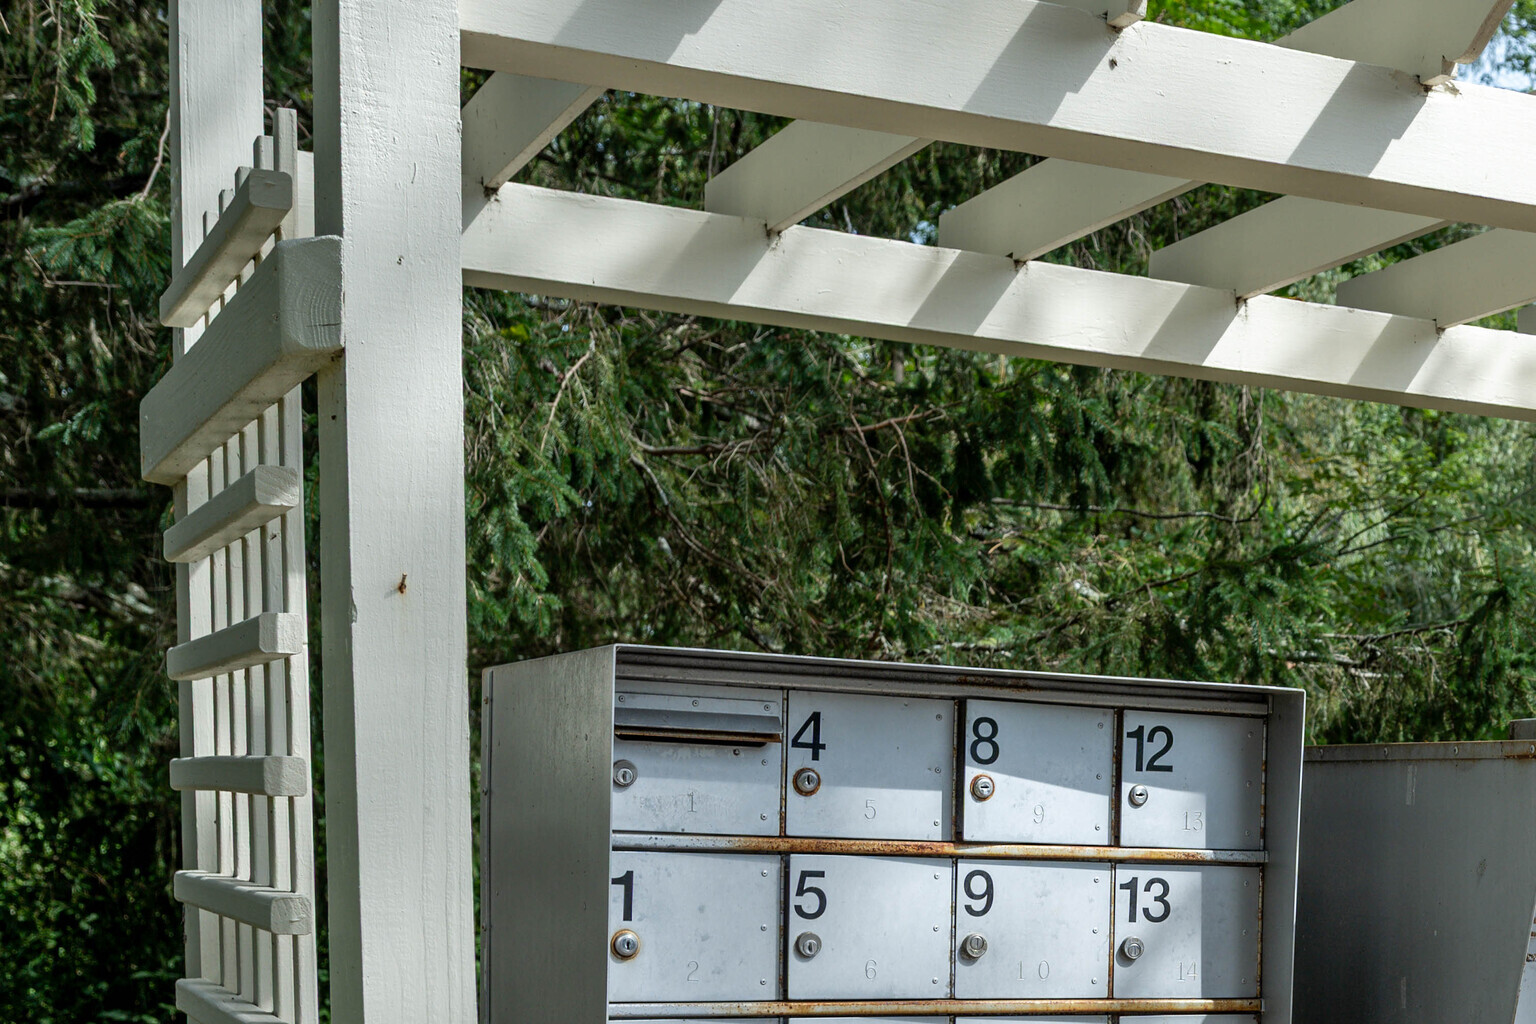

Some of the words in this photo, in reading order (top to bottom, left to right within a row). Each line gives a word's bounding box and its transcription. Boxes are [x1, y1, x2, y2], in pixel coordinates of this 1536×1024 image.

[790, 711, 827, 762] 4
[969, 716, 1000, 766] 8
[1126, 724, 1174, 773] 12
[864, 799, 877, 820] 5
[1032, 804, 1045, 824] 9
[1182, 810, 1204, 832] 13
[610, 870, 634, 922] 1
[793, 870, 827, 920] 5
[963, 869, 994, 918] 9
[1119, 876, 1172, 924] 13
[687, 961, 700, 982] 2
[864, 959, 877, 981] 6
[1016, 959, 1050, 981] 10
[1176, 961, 1197, 982] 14
